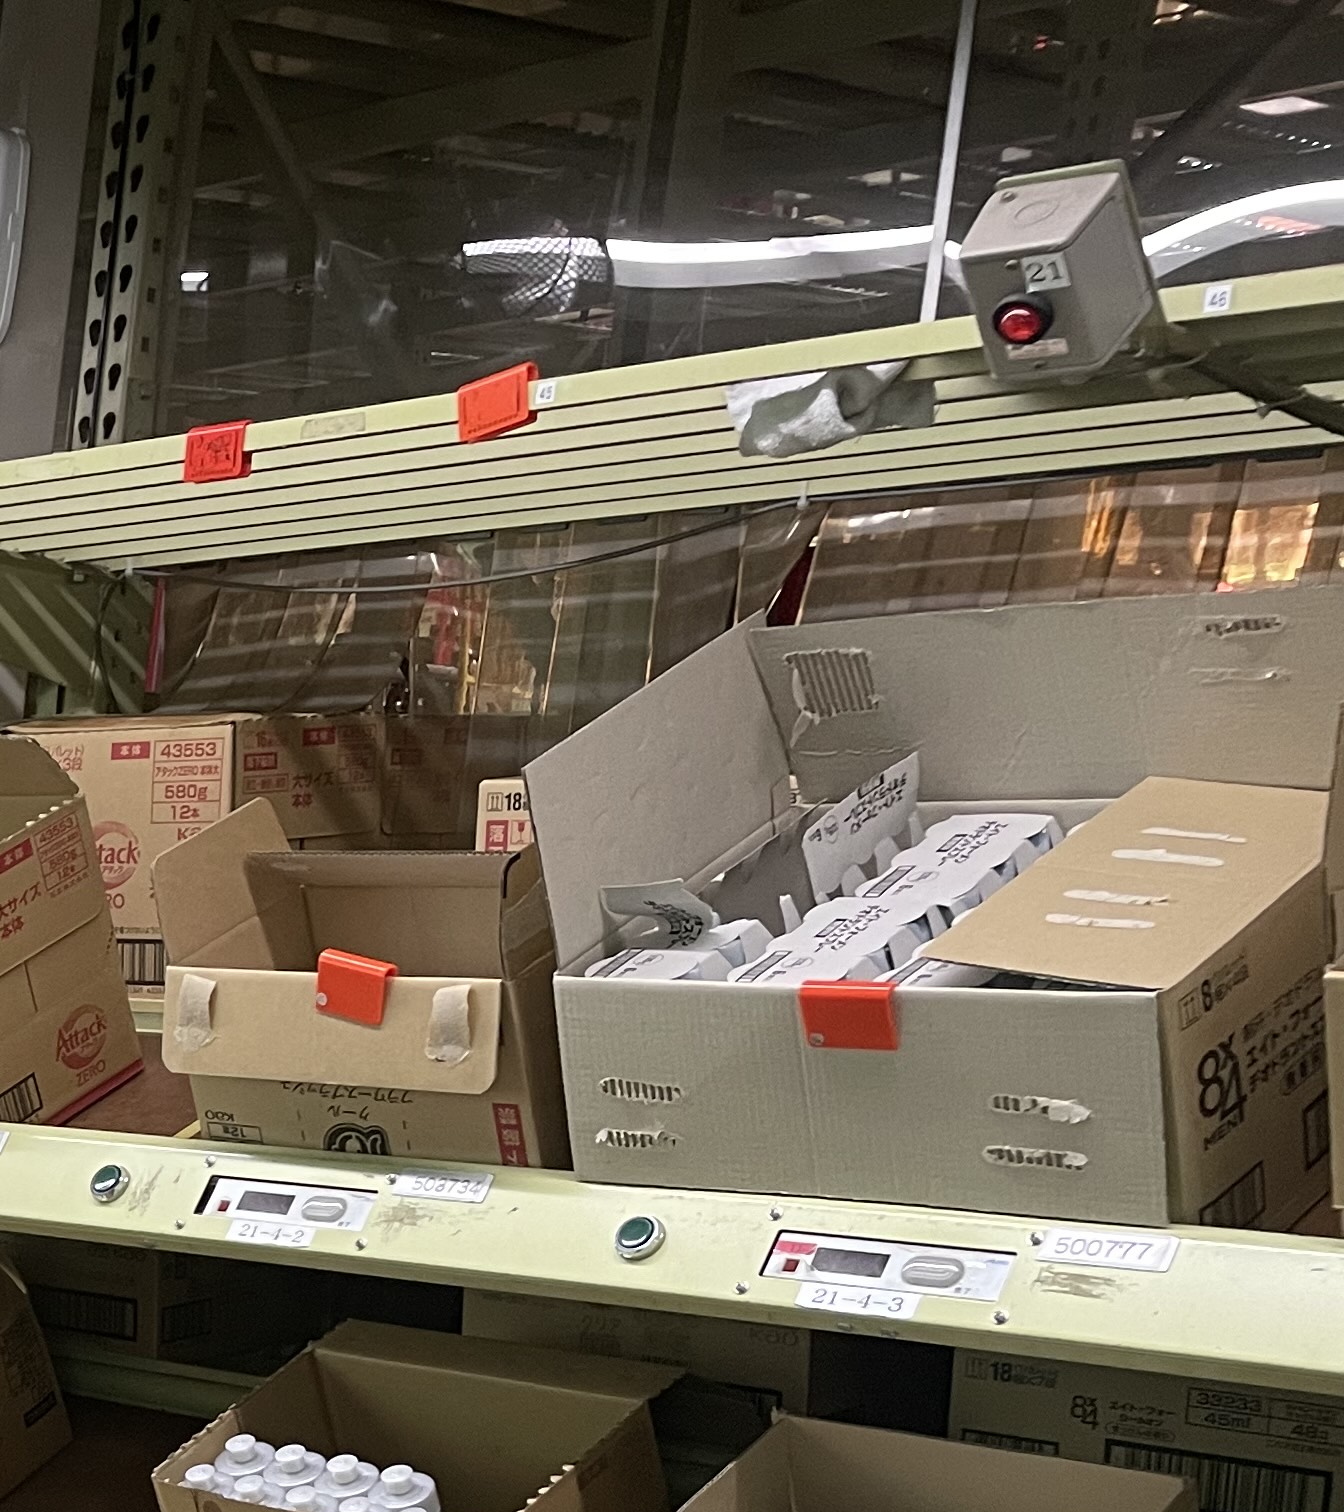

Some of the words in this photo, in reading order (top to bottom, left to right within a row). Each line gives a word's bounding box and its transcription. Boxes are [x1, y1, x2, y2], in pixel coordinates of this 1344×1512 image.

[1025, 262, 1062, 283] 21
[160, 743, 218, 758] 43553
[503, 792, 522, 811] 18
[96, 840, 139, 866] tack
[54, 1012, 109, 1064] Attack
[75, 1059, 107, 1087] ZERO
[237, 1223, 305, 1244] 21-4-2
[1053, 1236, 1153, 1261] 500777
[810, 1288, 905, 1313] 21-4-3
[990, 1360, 1012, 1383] 18
